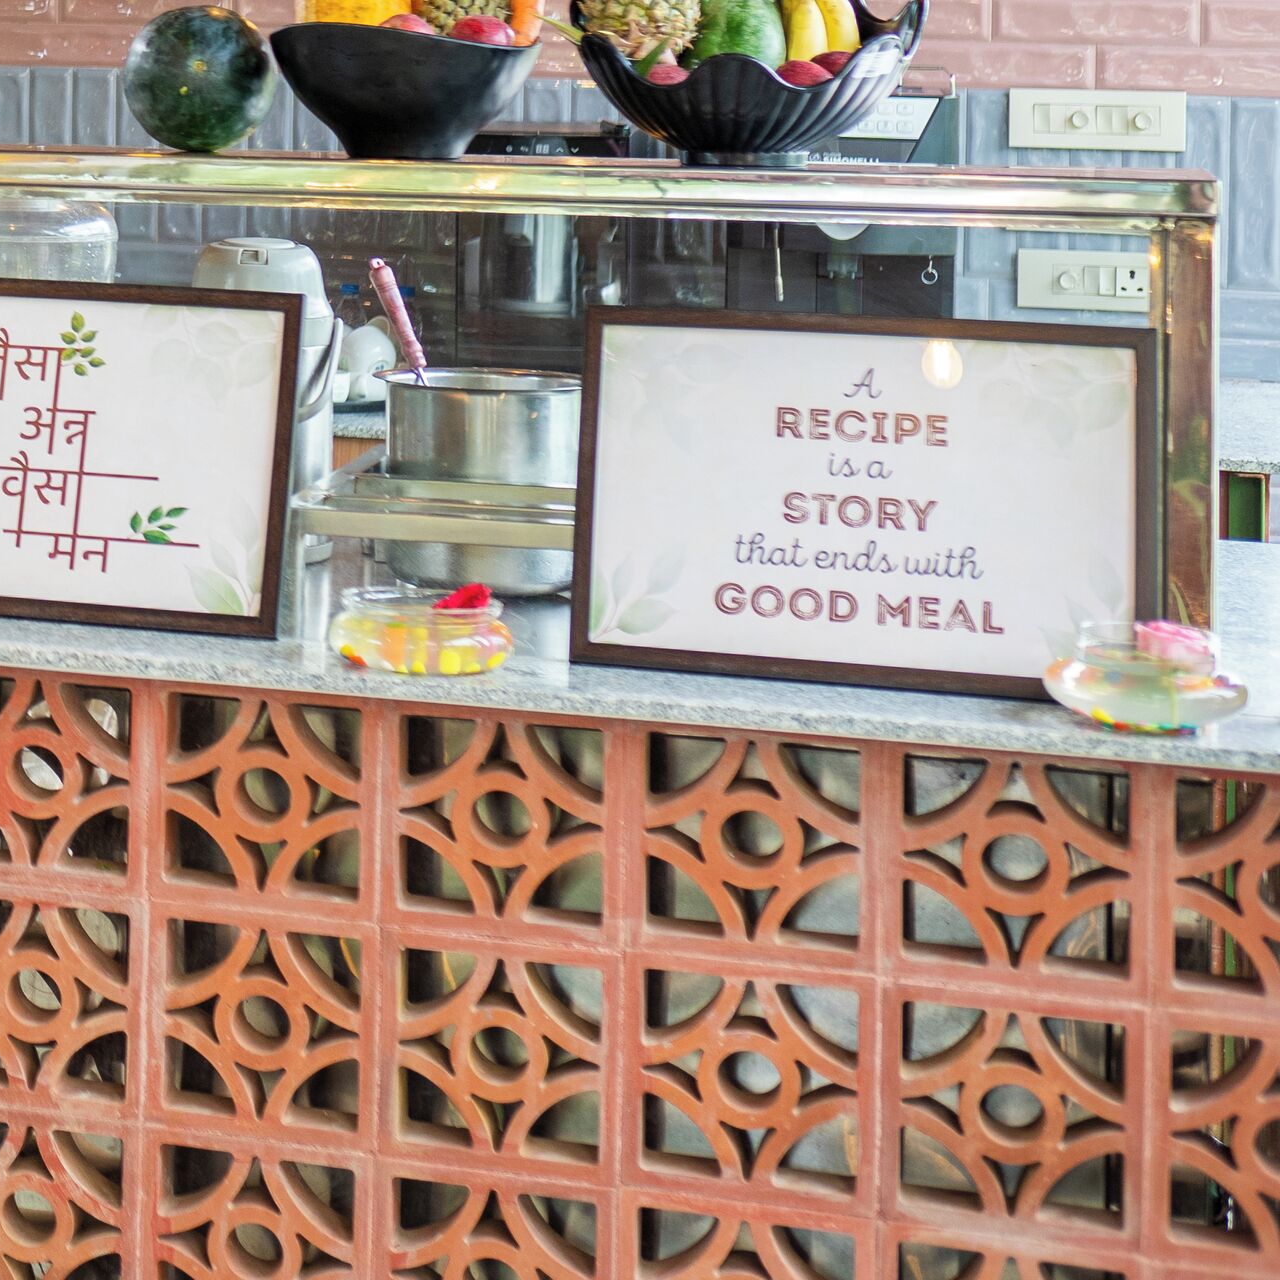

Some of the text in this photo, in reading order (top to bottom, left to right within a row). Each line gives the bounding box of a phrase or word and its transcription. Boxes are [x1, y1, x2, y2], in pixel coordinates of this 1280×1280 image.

[843, 367, 882, 399] A
[19, 405, 96, 472] अन्न
[775, 406, 949, 447] RECIPE
[828, 452, 893, 480] is a
[782, 491, 938, 531] STORY
[735, 532, 984, 580] that ends with
[714, 582, 1005, 635] GOOD MEAL
